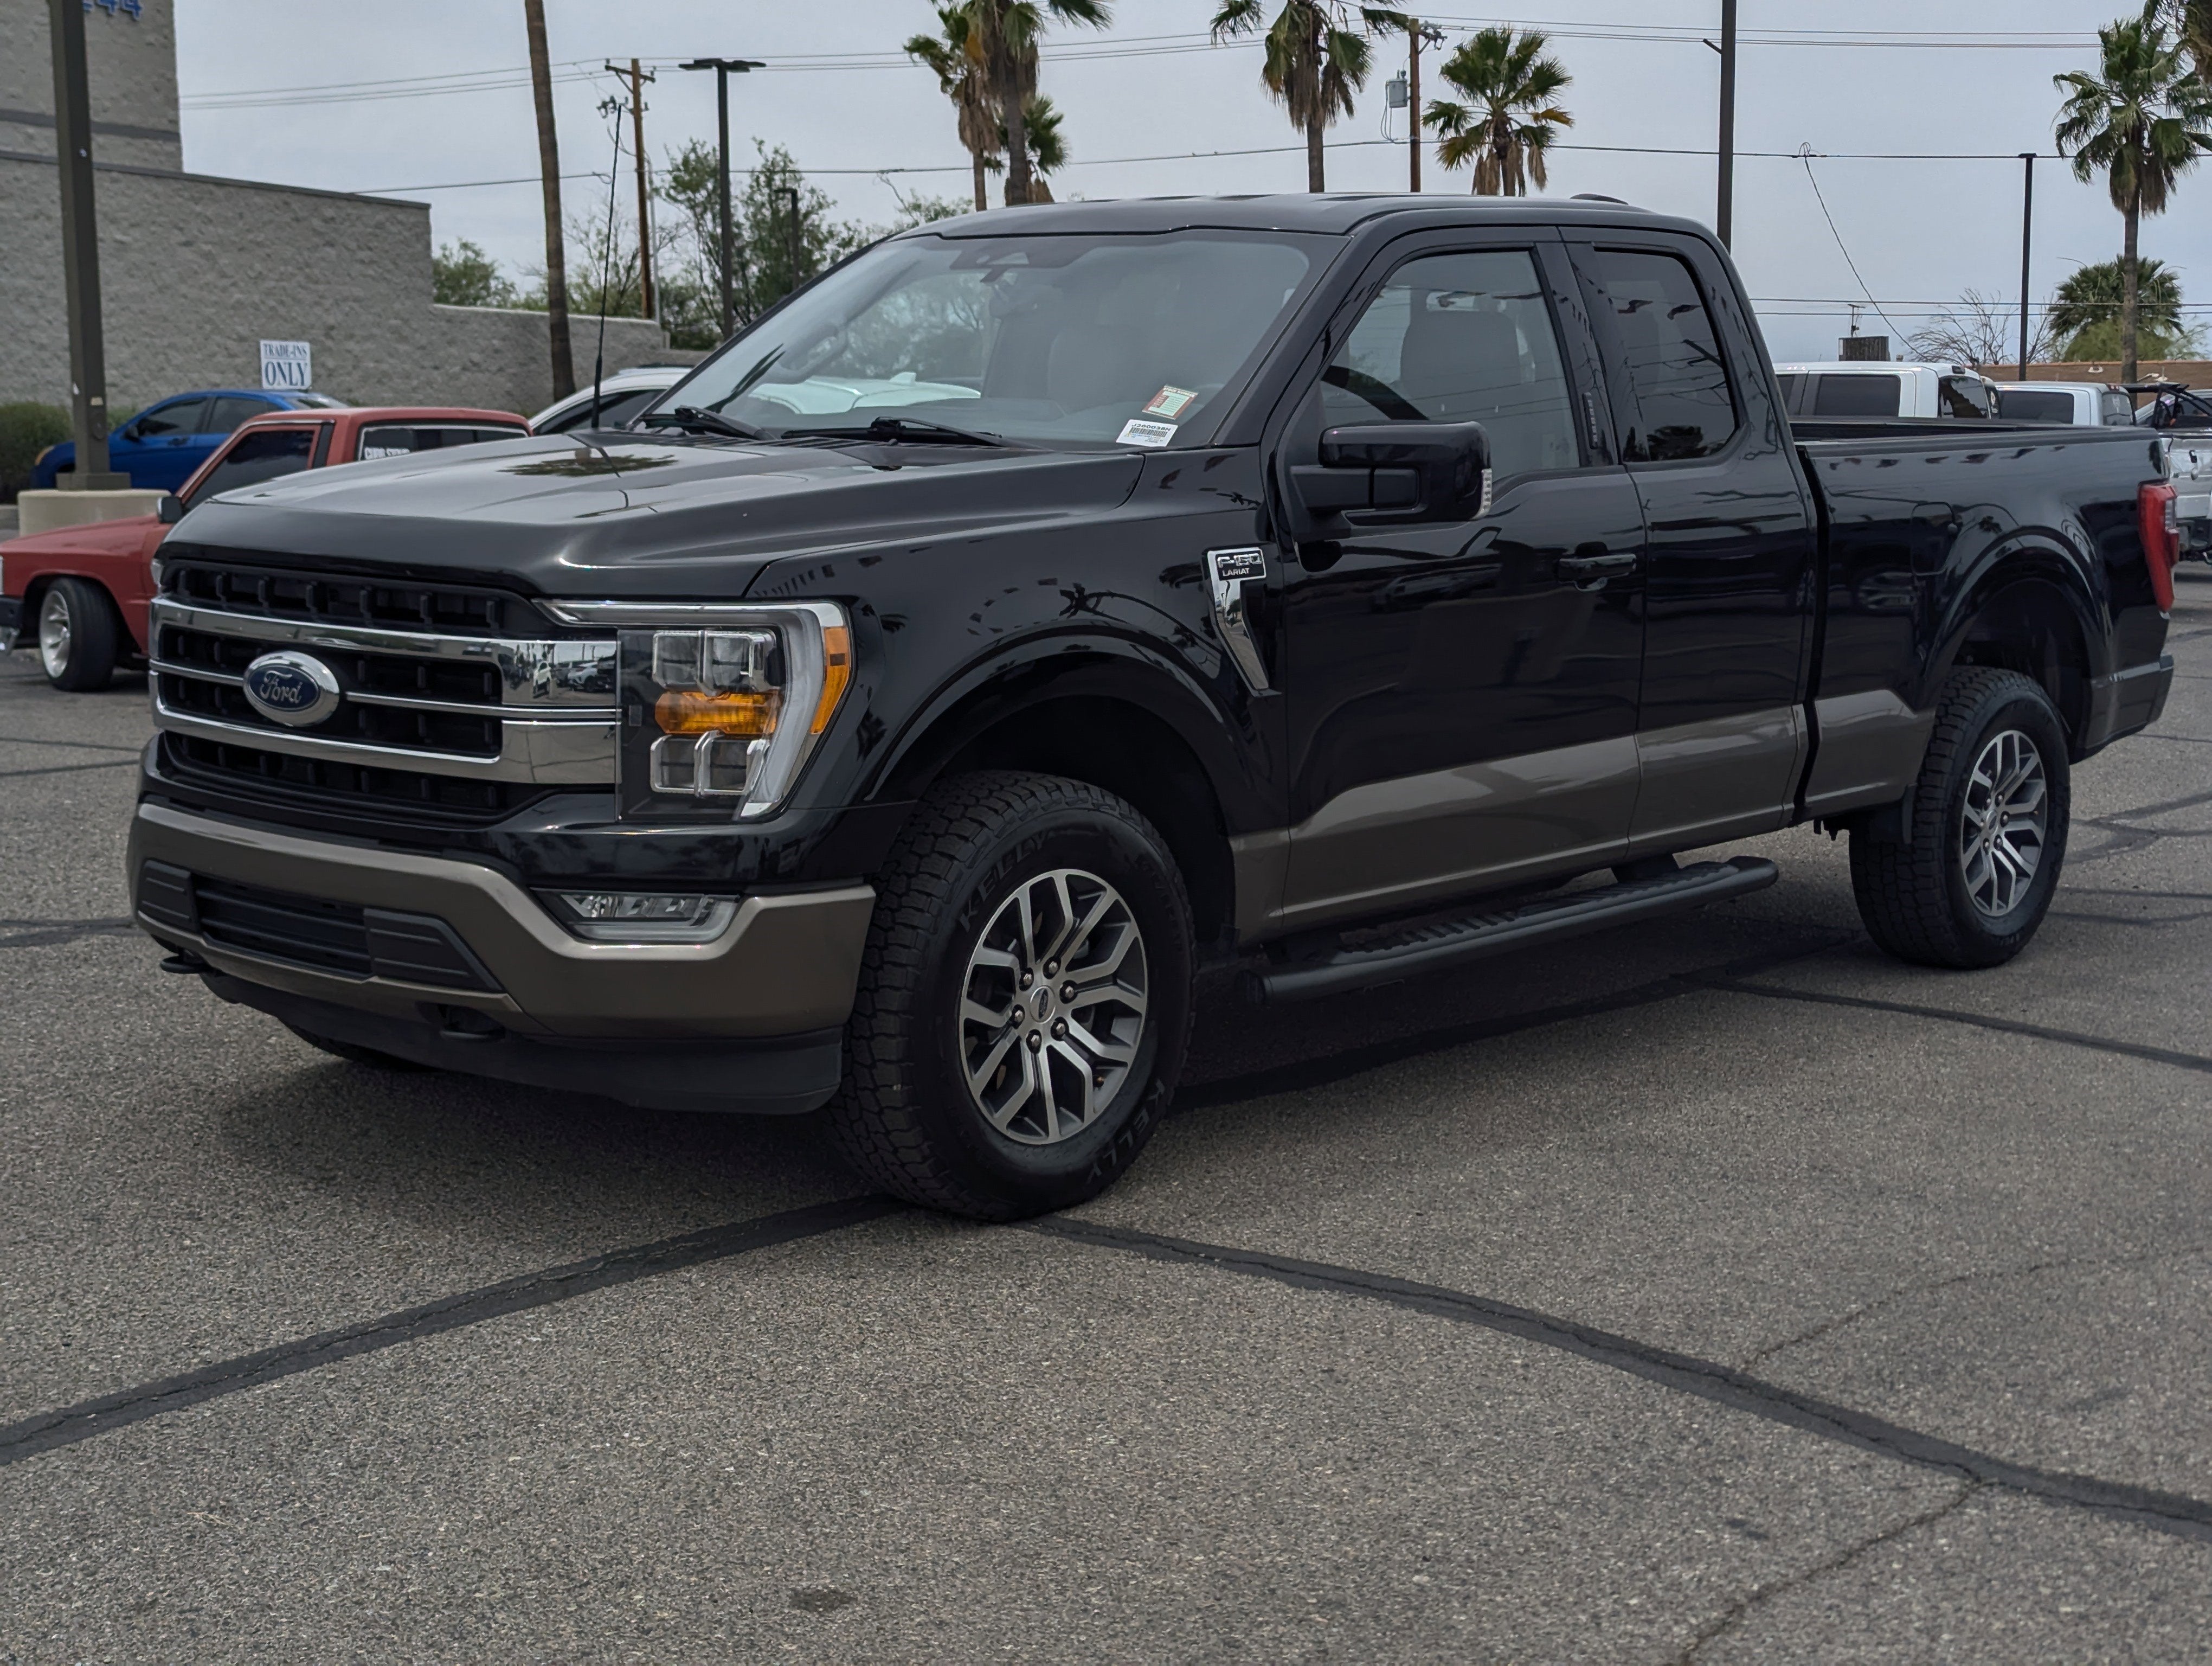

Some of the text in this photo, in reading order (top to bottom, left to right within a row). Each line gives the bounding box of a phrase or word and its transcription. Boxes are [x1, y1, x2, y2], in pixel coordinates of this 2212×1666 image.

[263, 343, 307, 357] TRADE-INS
[265, 361, 307, 386] ONLY
[1217, 553, 1262, 568] F-150
[1223, 568, 1250, 576] LARIAT
[260, 670, 302, 704] Ford
[959, 829, 1047, 933] KELLY
[1086, 1078, 1165, 1184] KELLY
